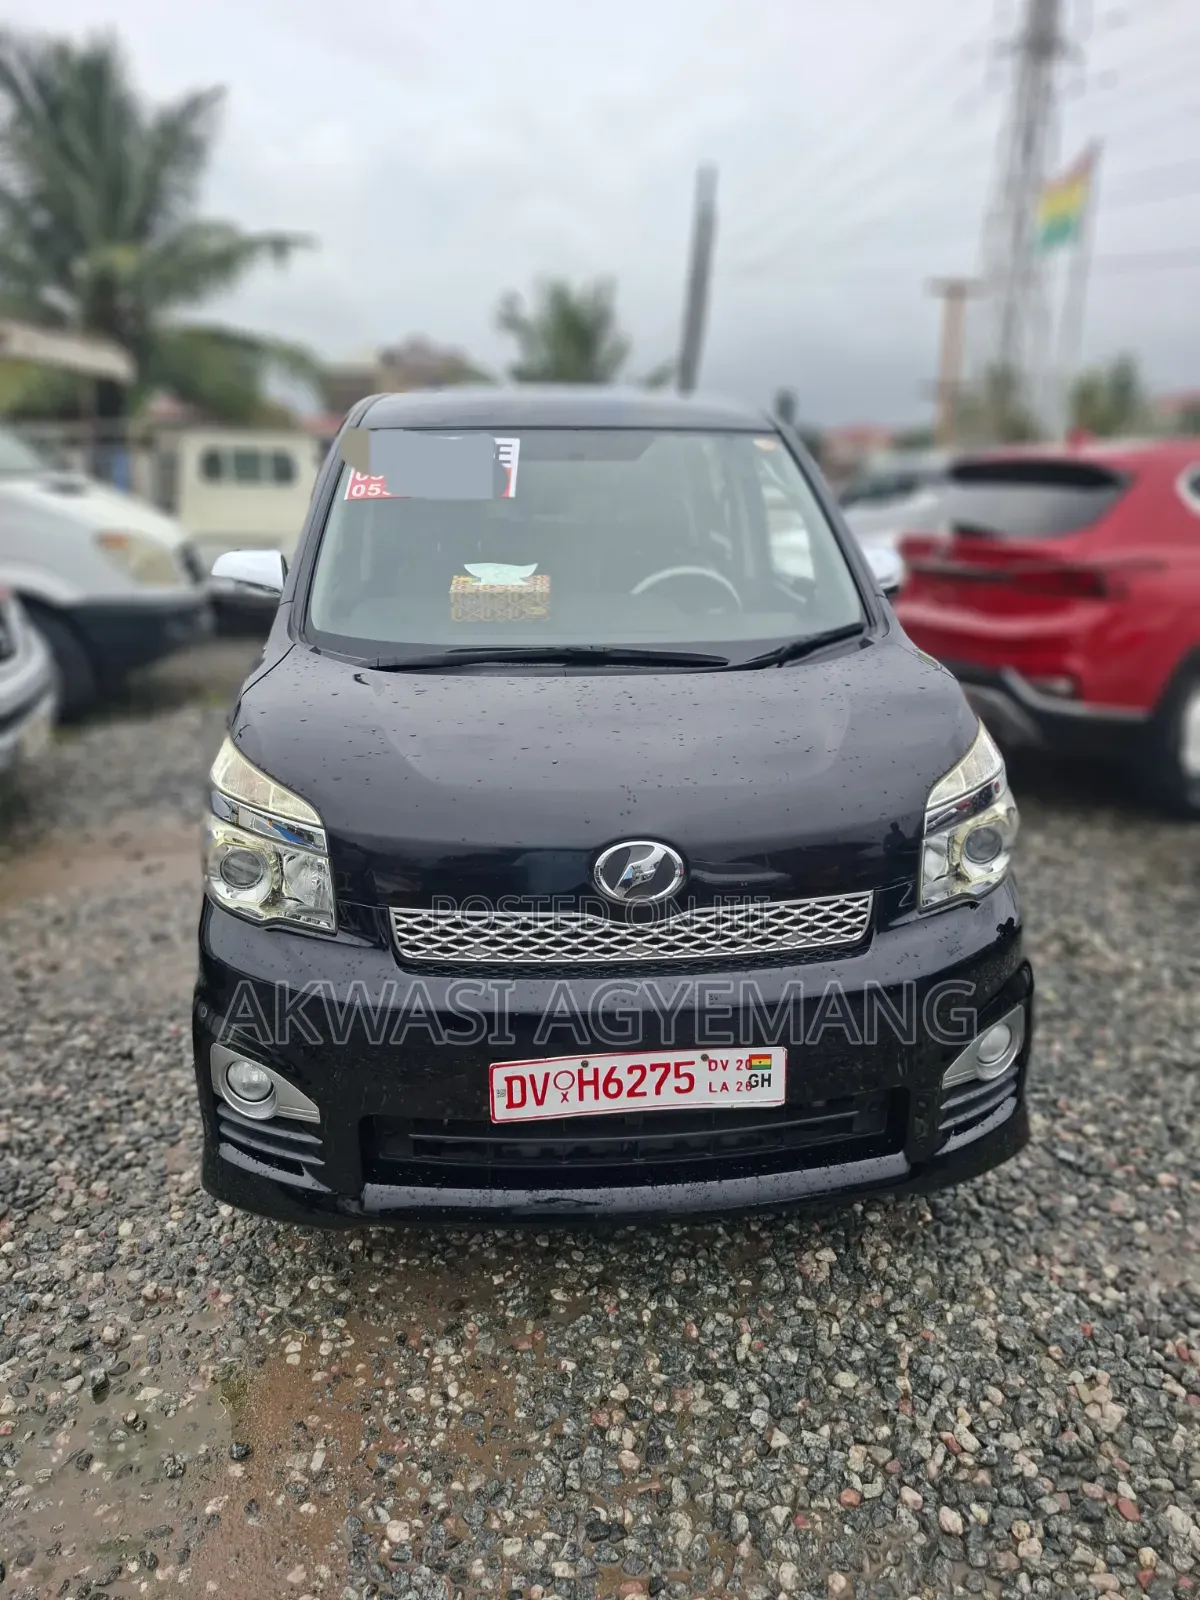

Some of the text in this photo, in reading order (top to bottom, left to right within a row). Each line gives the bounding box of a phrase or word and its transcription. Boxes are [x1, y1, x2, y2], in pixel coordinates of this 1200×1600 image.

[351, 483, 391, 497] 05
[708, 1058, 729, 1071] DV
[504, 1061, 695, 1109] DV H6275
[708, 1081, 729, 1093] LA
[748, 1073, 772, 1088] GH
